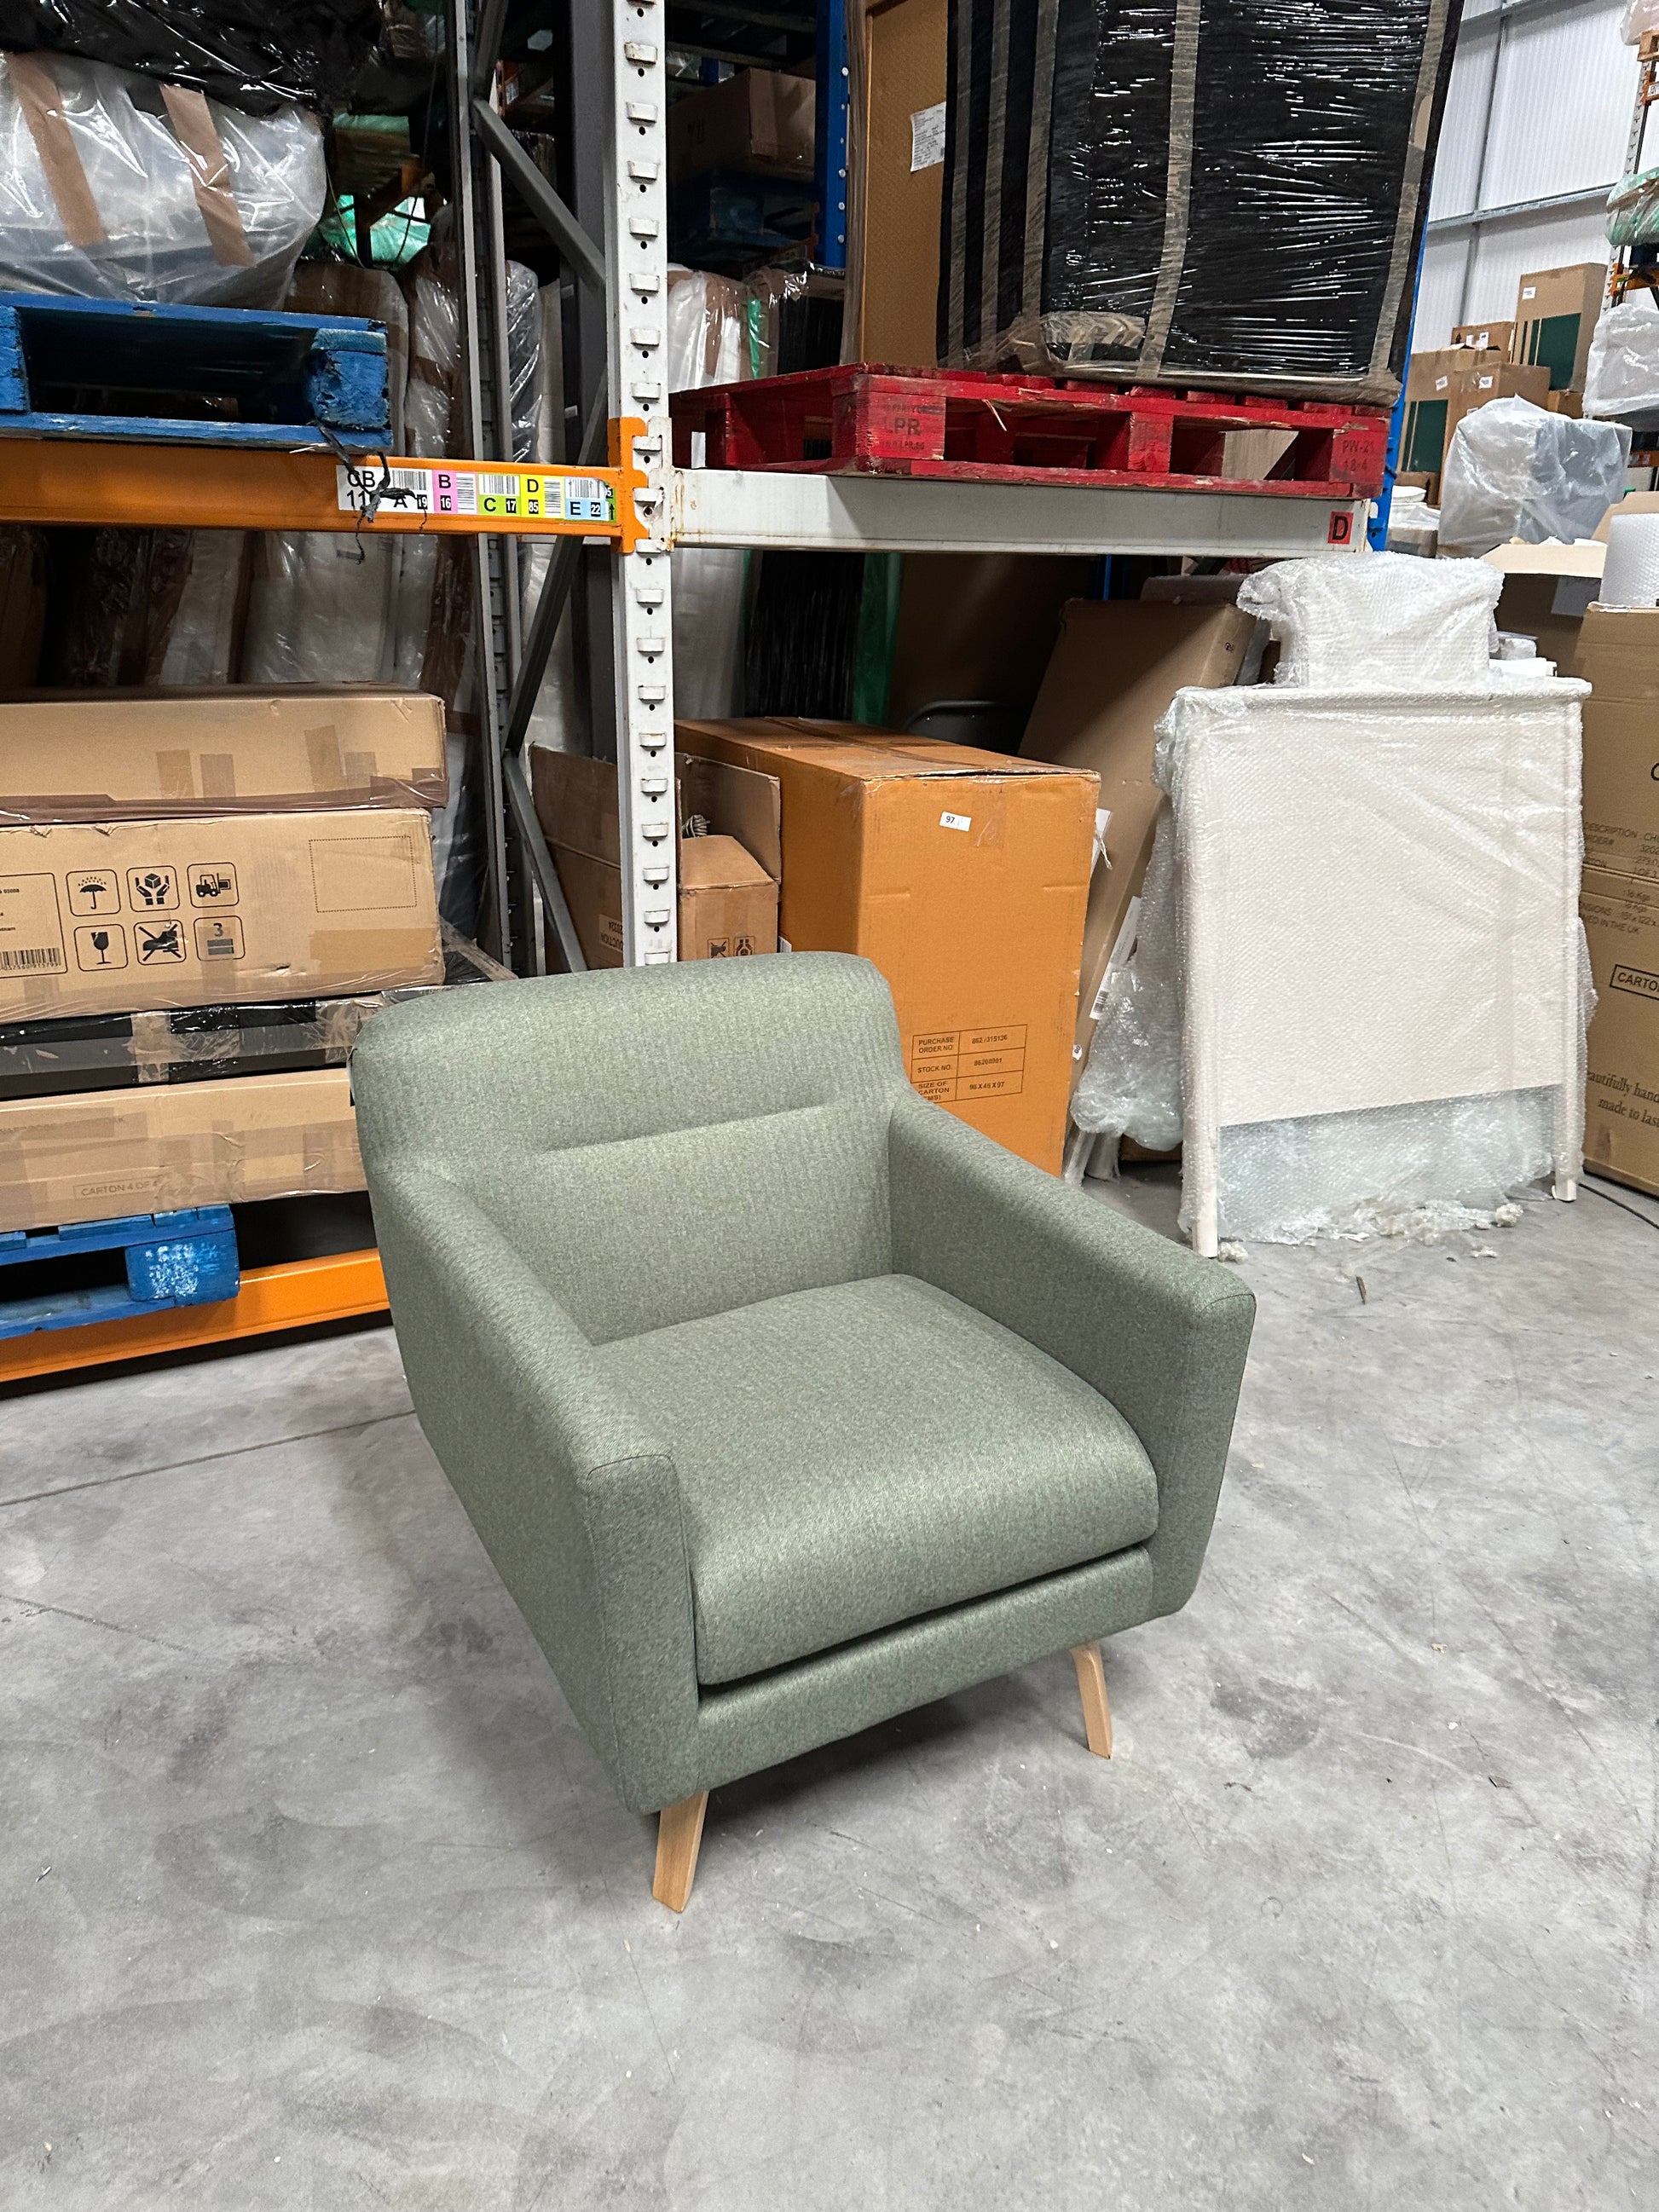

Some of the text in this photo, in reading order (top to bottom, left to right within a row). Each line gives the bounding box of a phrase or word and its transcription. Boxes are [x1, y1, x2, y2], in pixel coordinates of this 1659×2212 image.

[438, 474, 452, 488] B
[527, 479, 539, 493] D
[394, 496, 408, 508] A
[440, 497, 452, 510] 16
[483, 498, 517, 512] C 17
[529, 500, 539, 513] 85
[569, 501, 601, 516] E 22
[1332, 515, 1348, 540] D
[945, 815, 955, 823] 97
[213, 923, 223, 937] 3
[1617, 972, 1659, 992] CARTO
[918, 1037, 955, 1046] PURCHASE
[917, 1066, 939, 1074] STOCK
[1587, 1070, 1633, 1097] eautifully
[1598, 1099, 1627, 1116] made
[1629, 1109, 1640, 1120] to
[81, 1184, 124, 1196] CARTON
